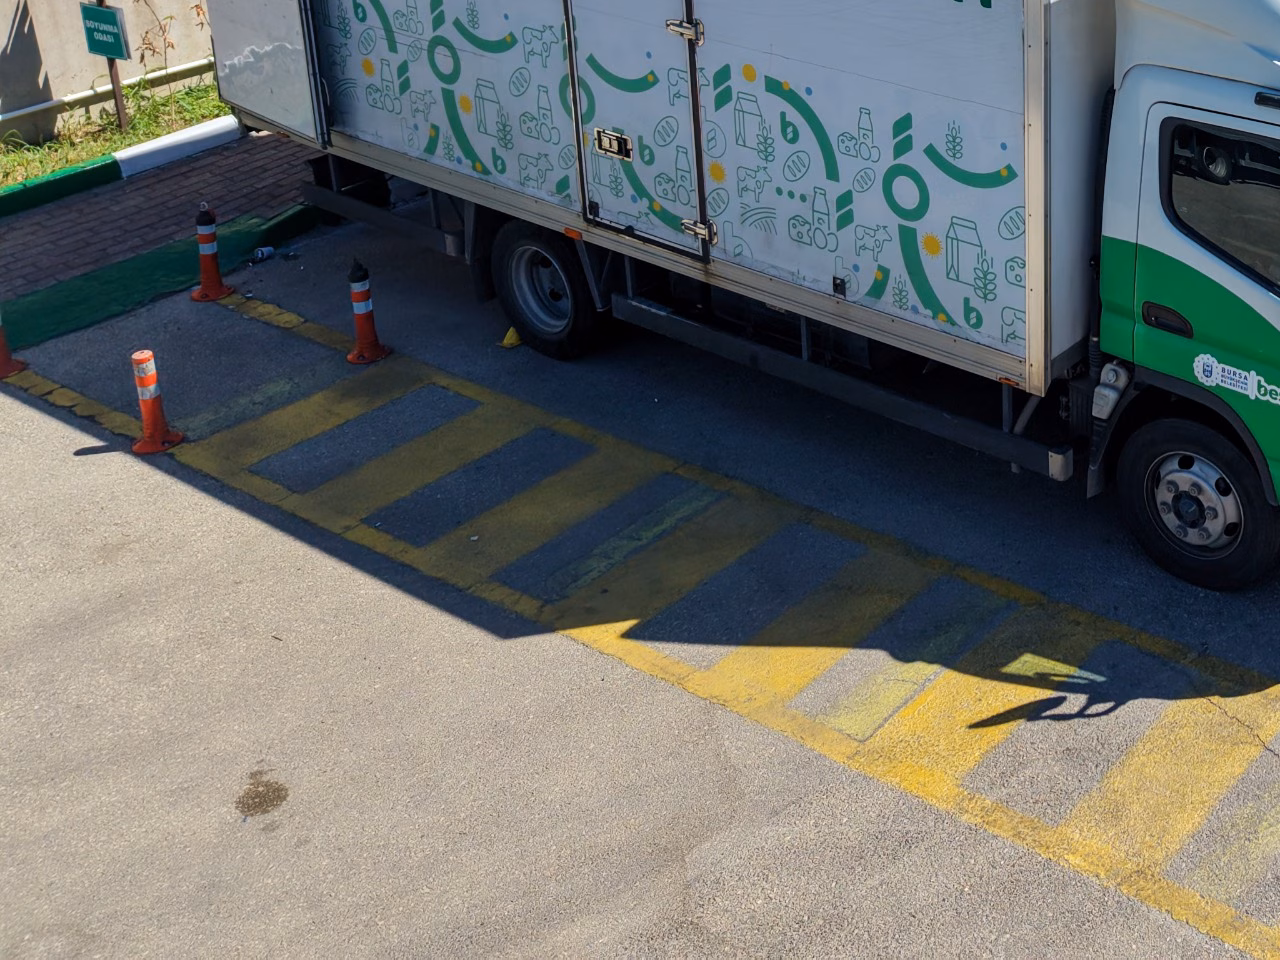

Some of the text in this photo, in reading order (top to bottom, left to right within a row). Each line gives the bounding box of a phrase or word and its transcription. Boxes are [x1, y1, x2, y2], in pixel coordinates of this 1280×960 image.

[85, 19, 119, 34] SOYUNMA
[93, 31, 115, 43] ODASI
[1221, 366, 1249, 381] BURSA
